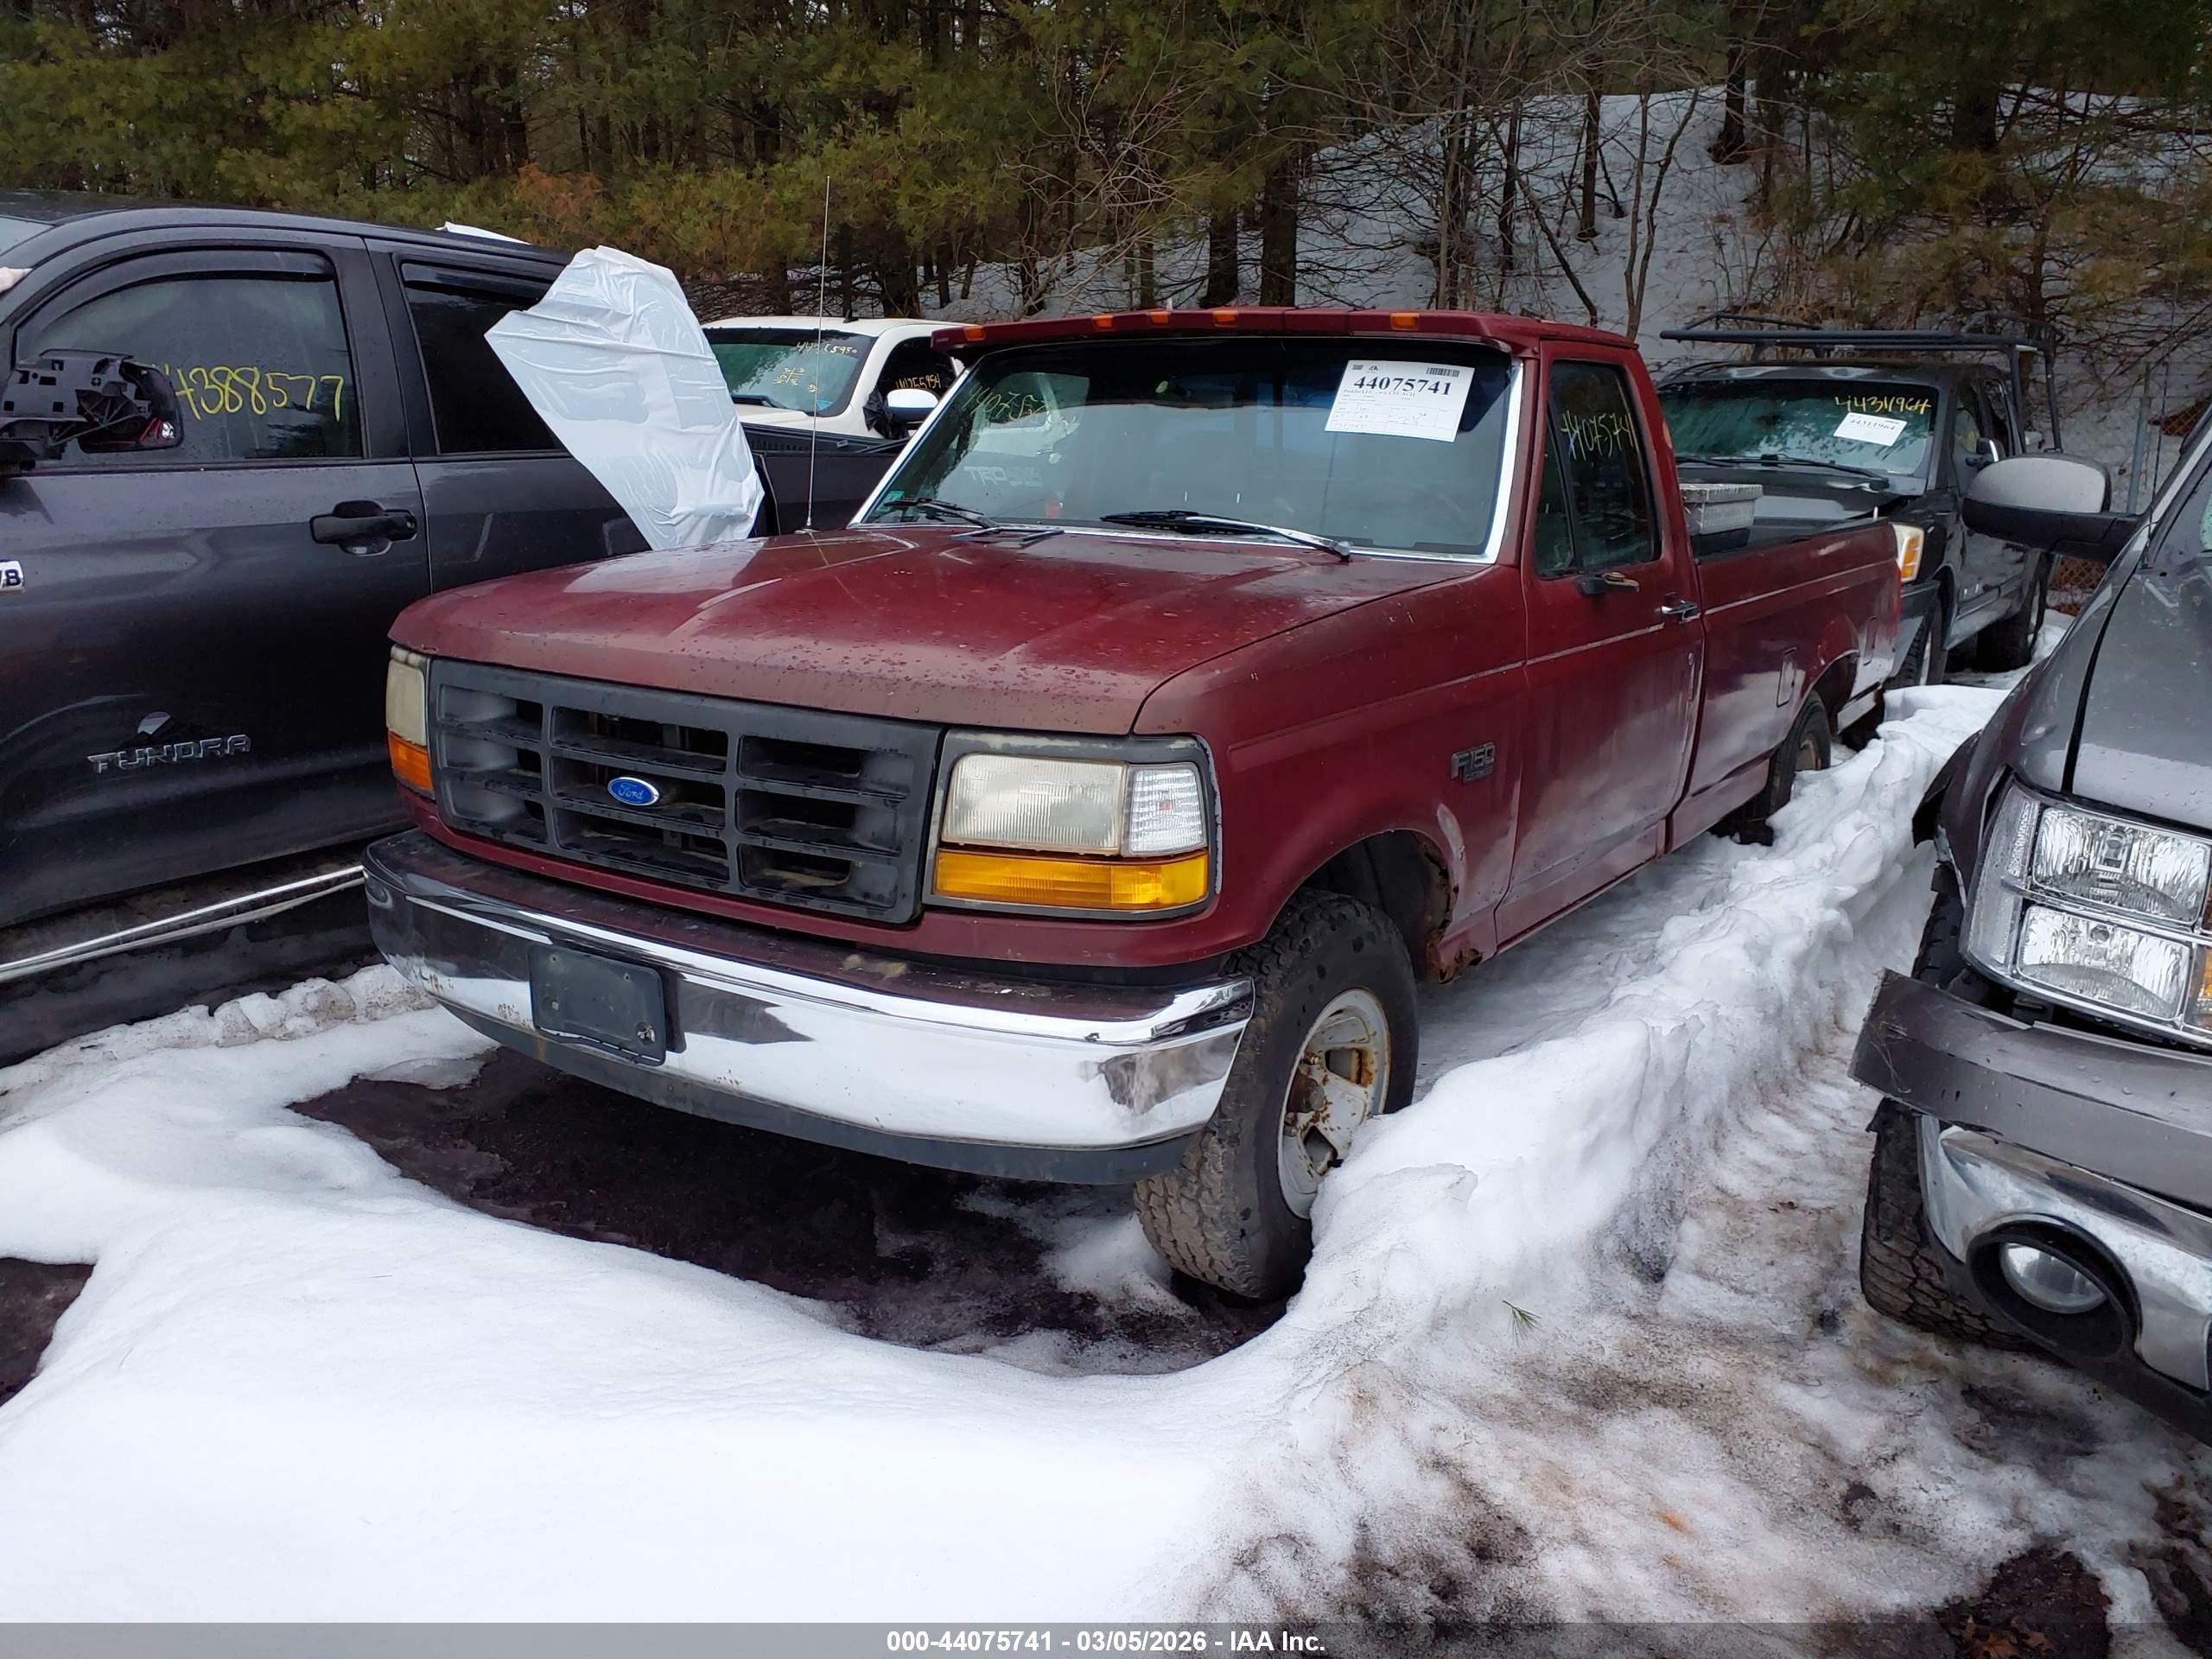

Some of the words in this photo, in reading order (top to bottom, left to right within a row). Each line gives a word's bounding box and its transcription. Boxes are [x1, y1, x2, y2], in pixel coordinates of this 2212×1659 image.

[1353, 376, 1452, 396] 44075741
[87, 734, 252, 774] TUNDRA
[618, 782, 645, 801] Ford
